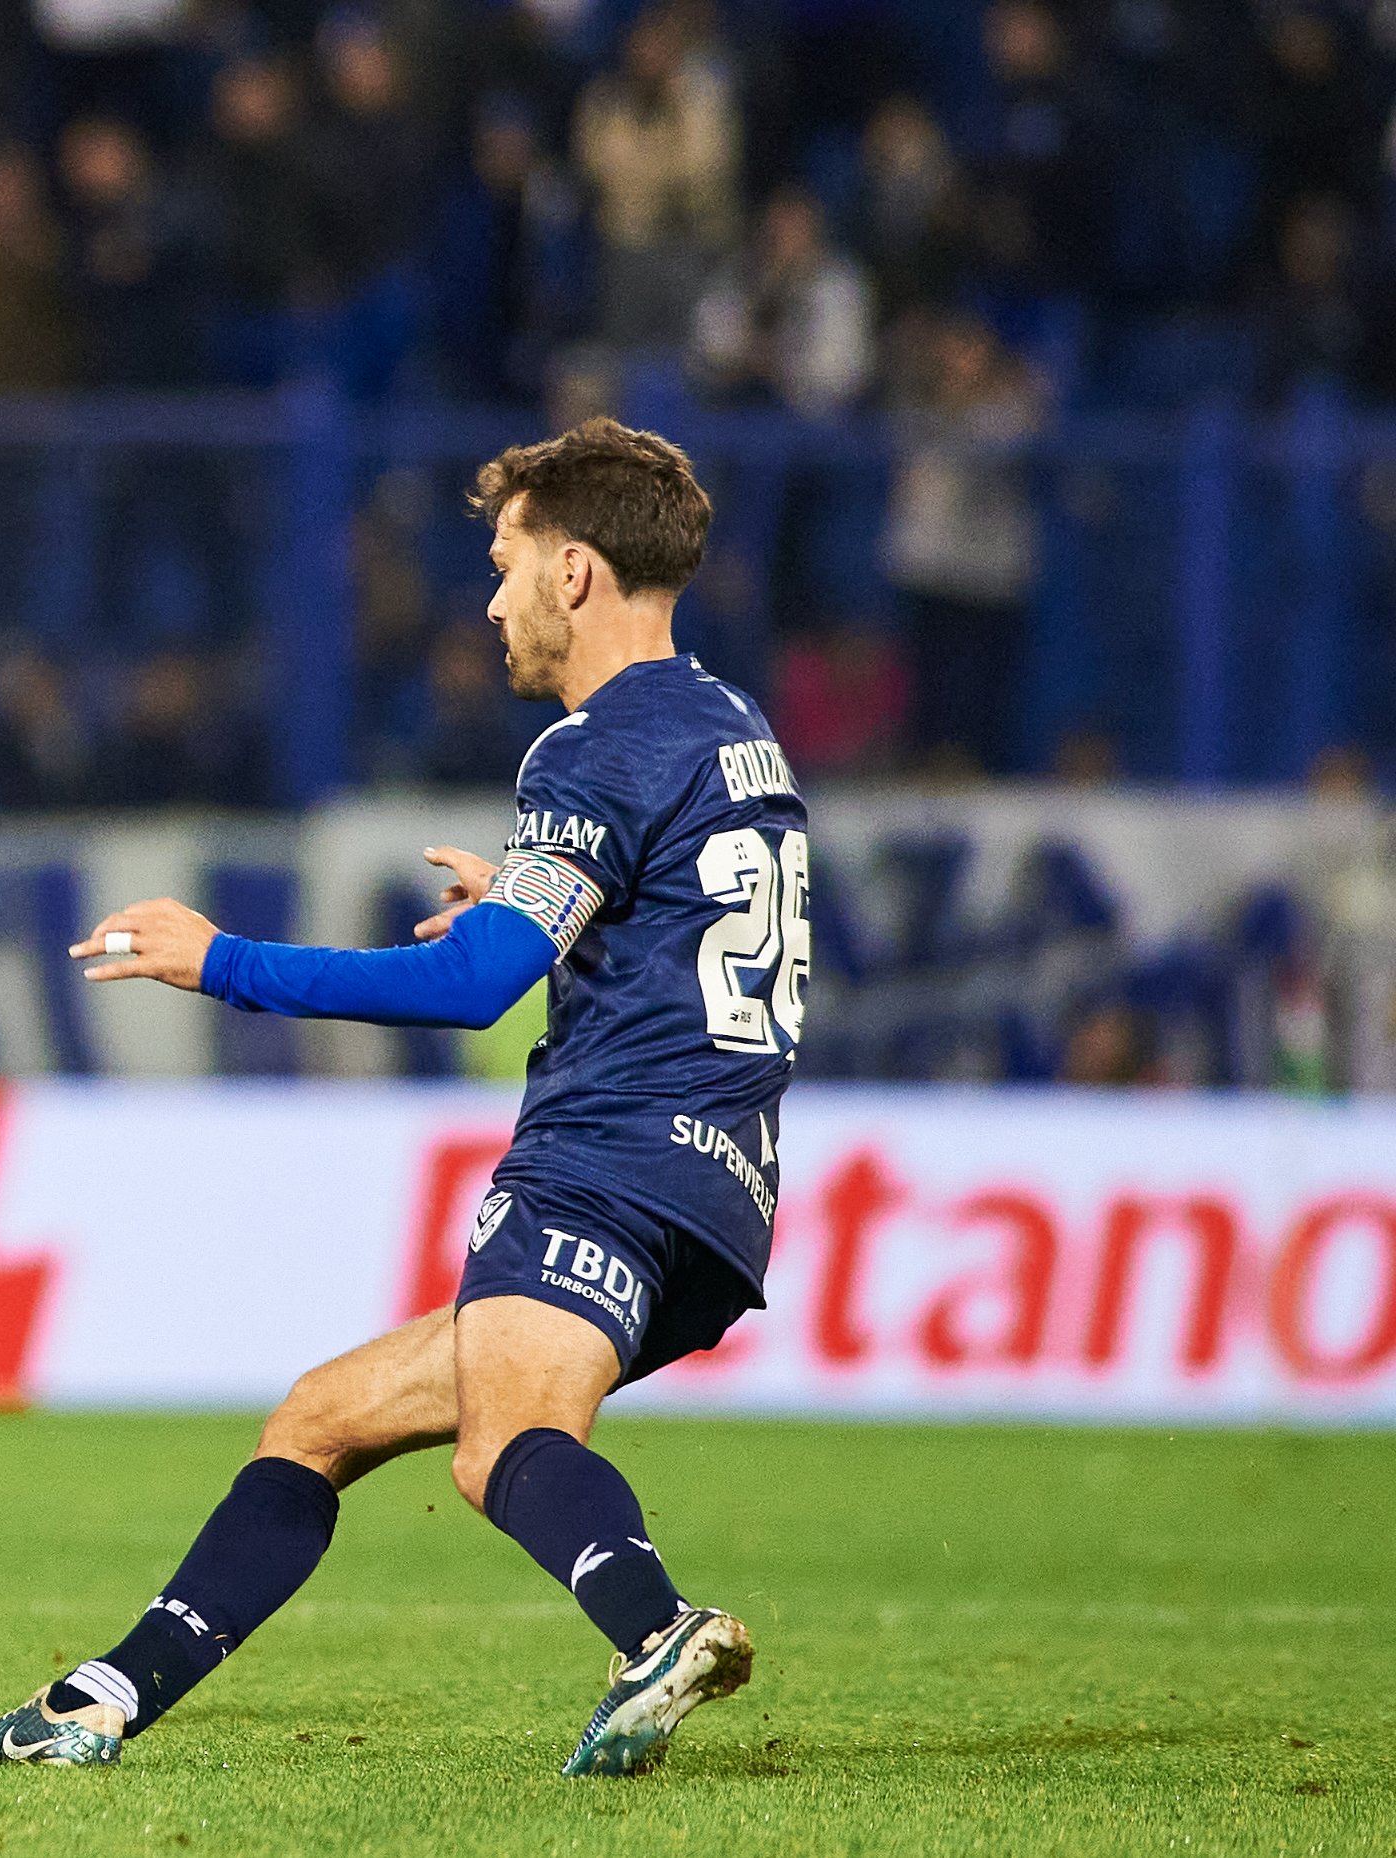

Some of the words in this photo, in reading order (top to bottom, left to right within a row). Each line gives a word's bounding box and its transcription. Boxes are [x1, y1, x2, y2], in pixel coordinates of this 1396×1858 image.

[503, 858, 561, 914] C
[669, 1113, 776, 1228] SUPERVIELLE
[540, 1269, 625, 1325] TURBODISEL
